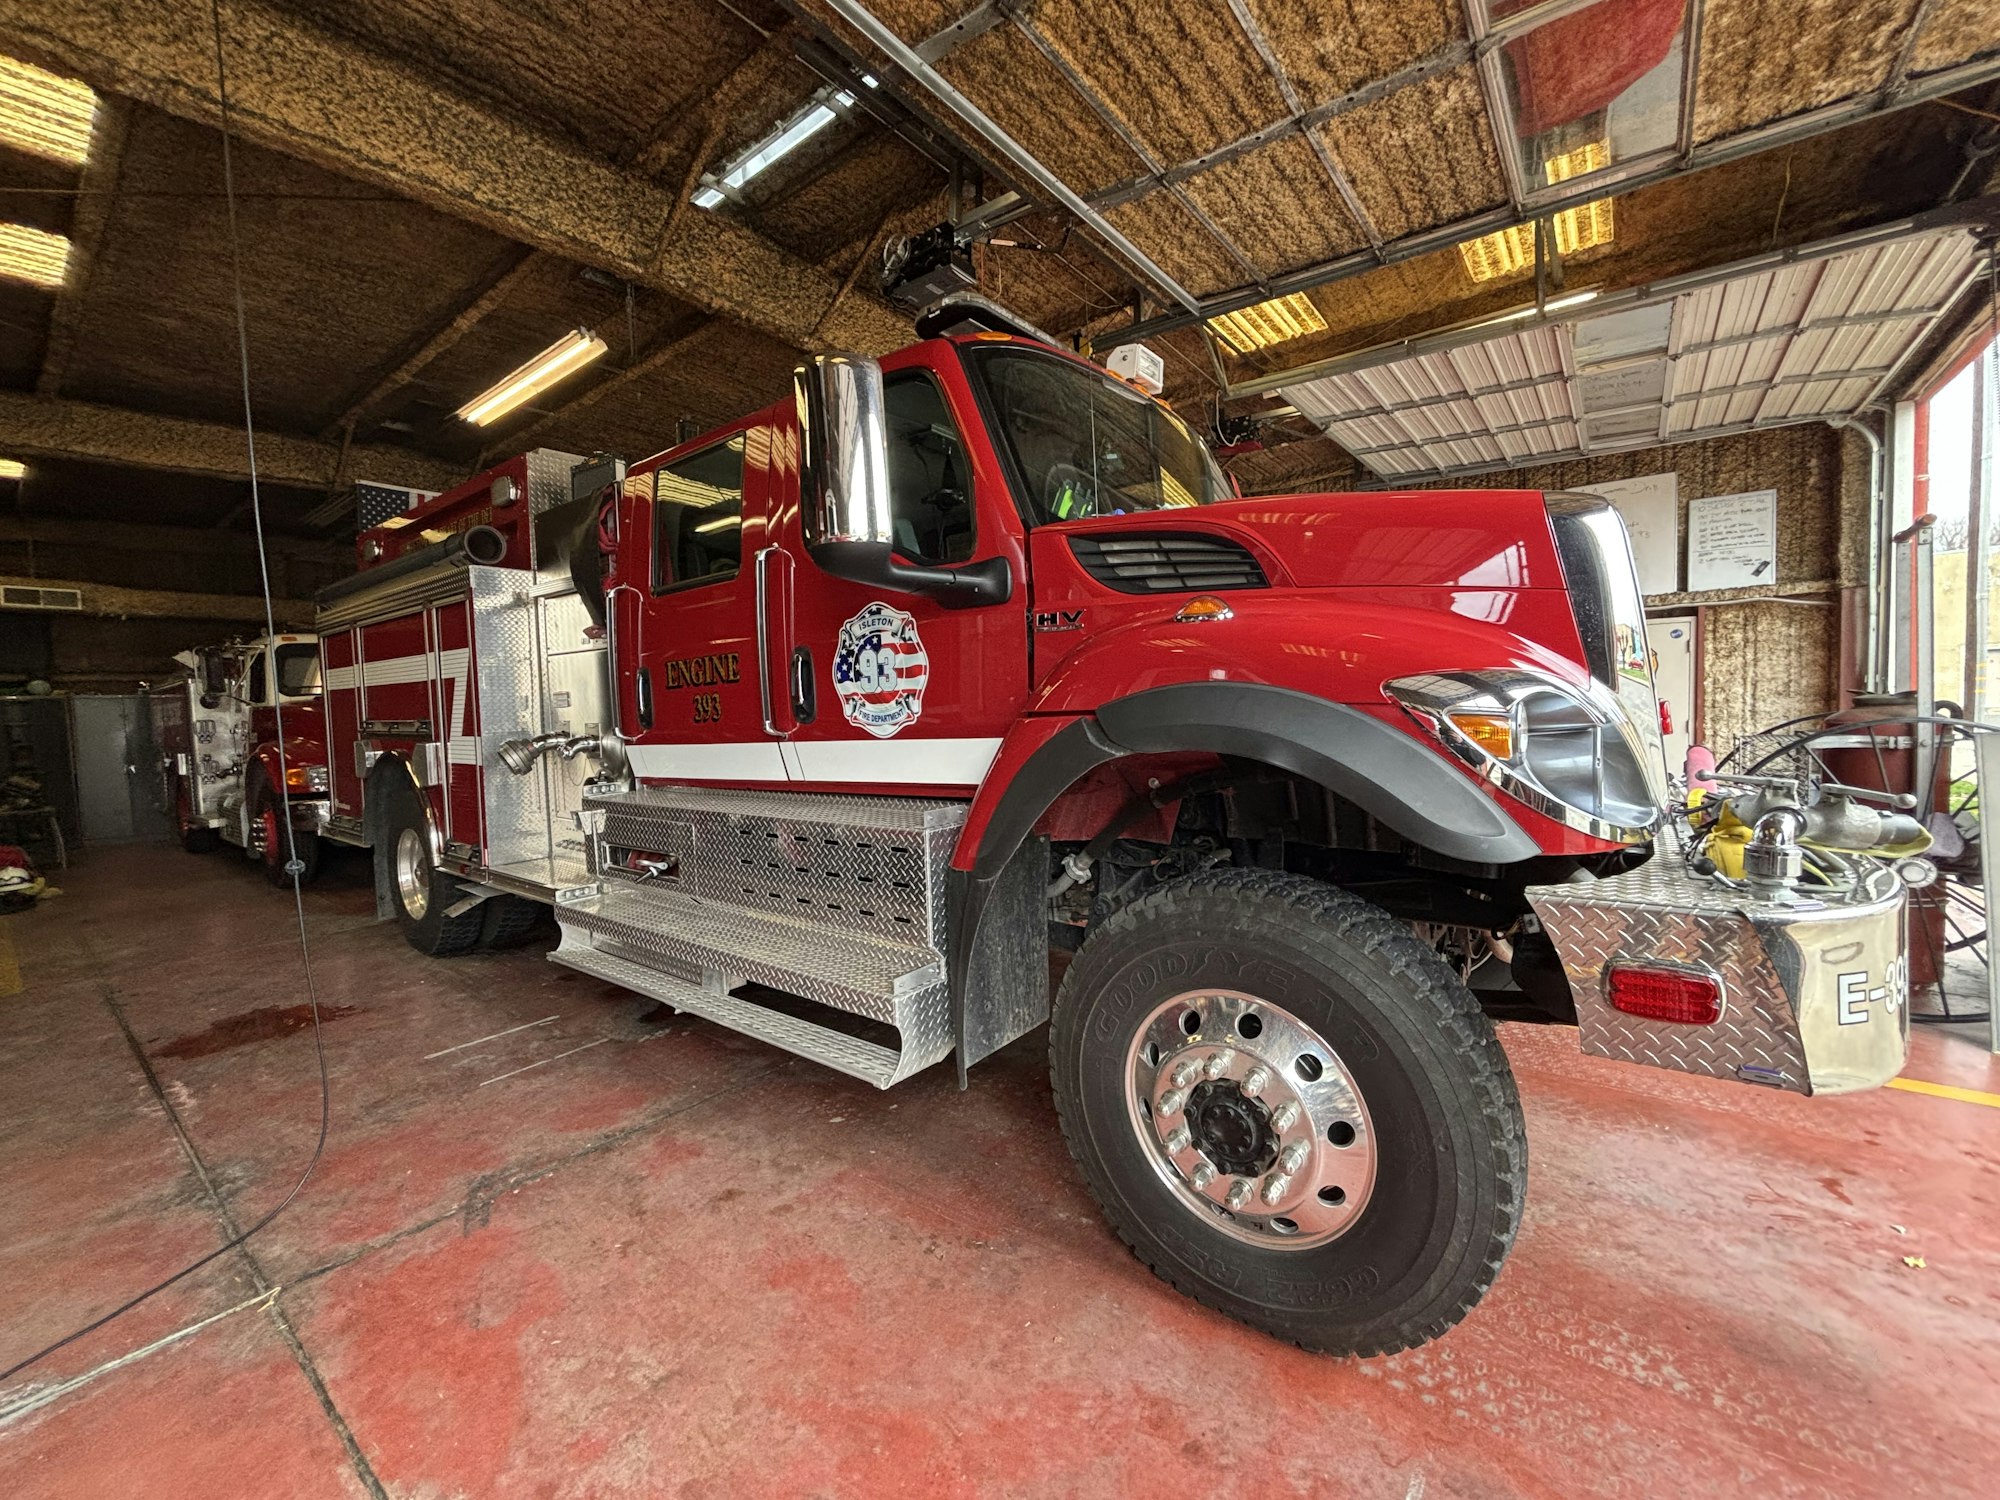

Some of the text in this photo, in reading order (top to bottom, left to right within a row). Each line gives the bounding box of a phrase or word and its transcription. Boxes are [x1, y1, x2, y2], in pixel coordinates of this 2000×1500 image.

[858, 617, 894, 631] ISLETON
[1036, 608, 1087, 626] HV
[666, 653, 741, 690] ENGINE
[859, 647, 898, 694] 93
[693, 692, 722, 724] 393
[859, 707, 905, 724] FIRE DEPARTMENT
[1094, 946, 1380, 1063] GOODYEAR
[1837, 952, 1907, 1026] E-39
